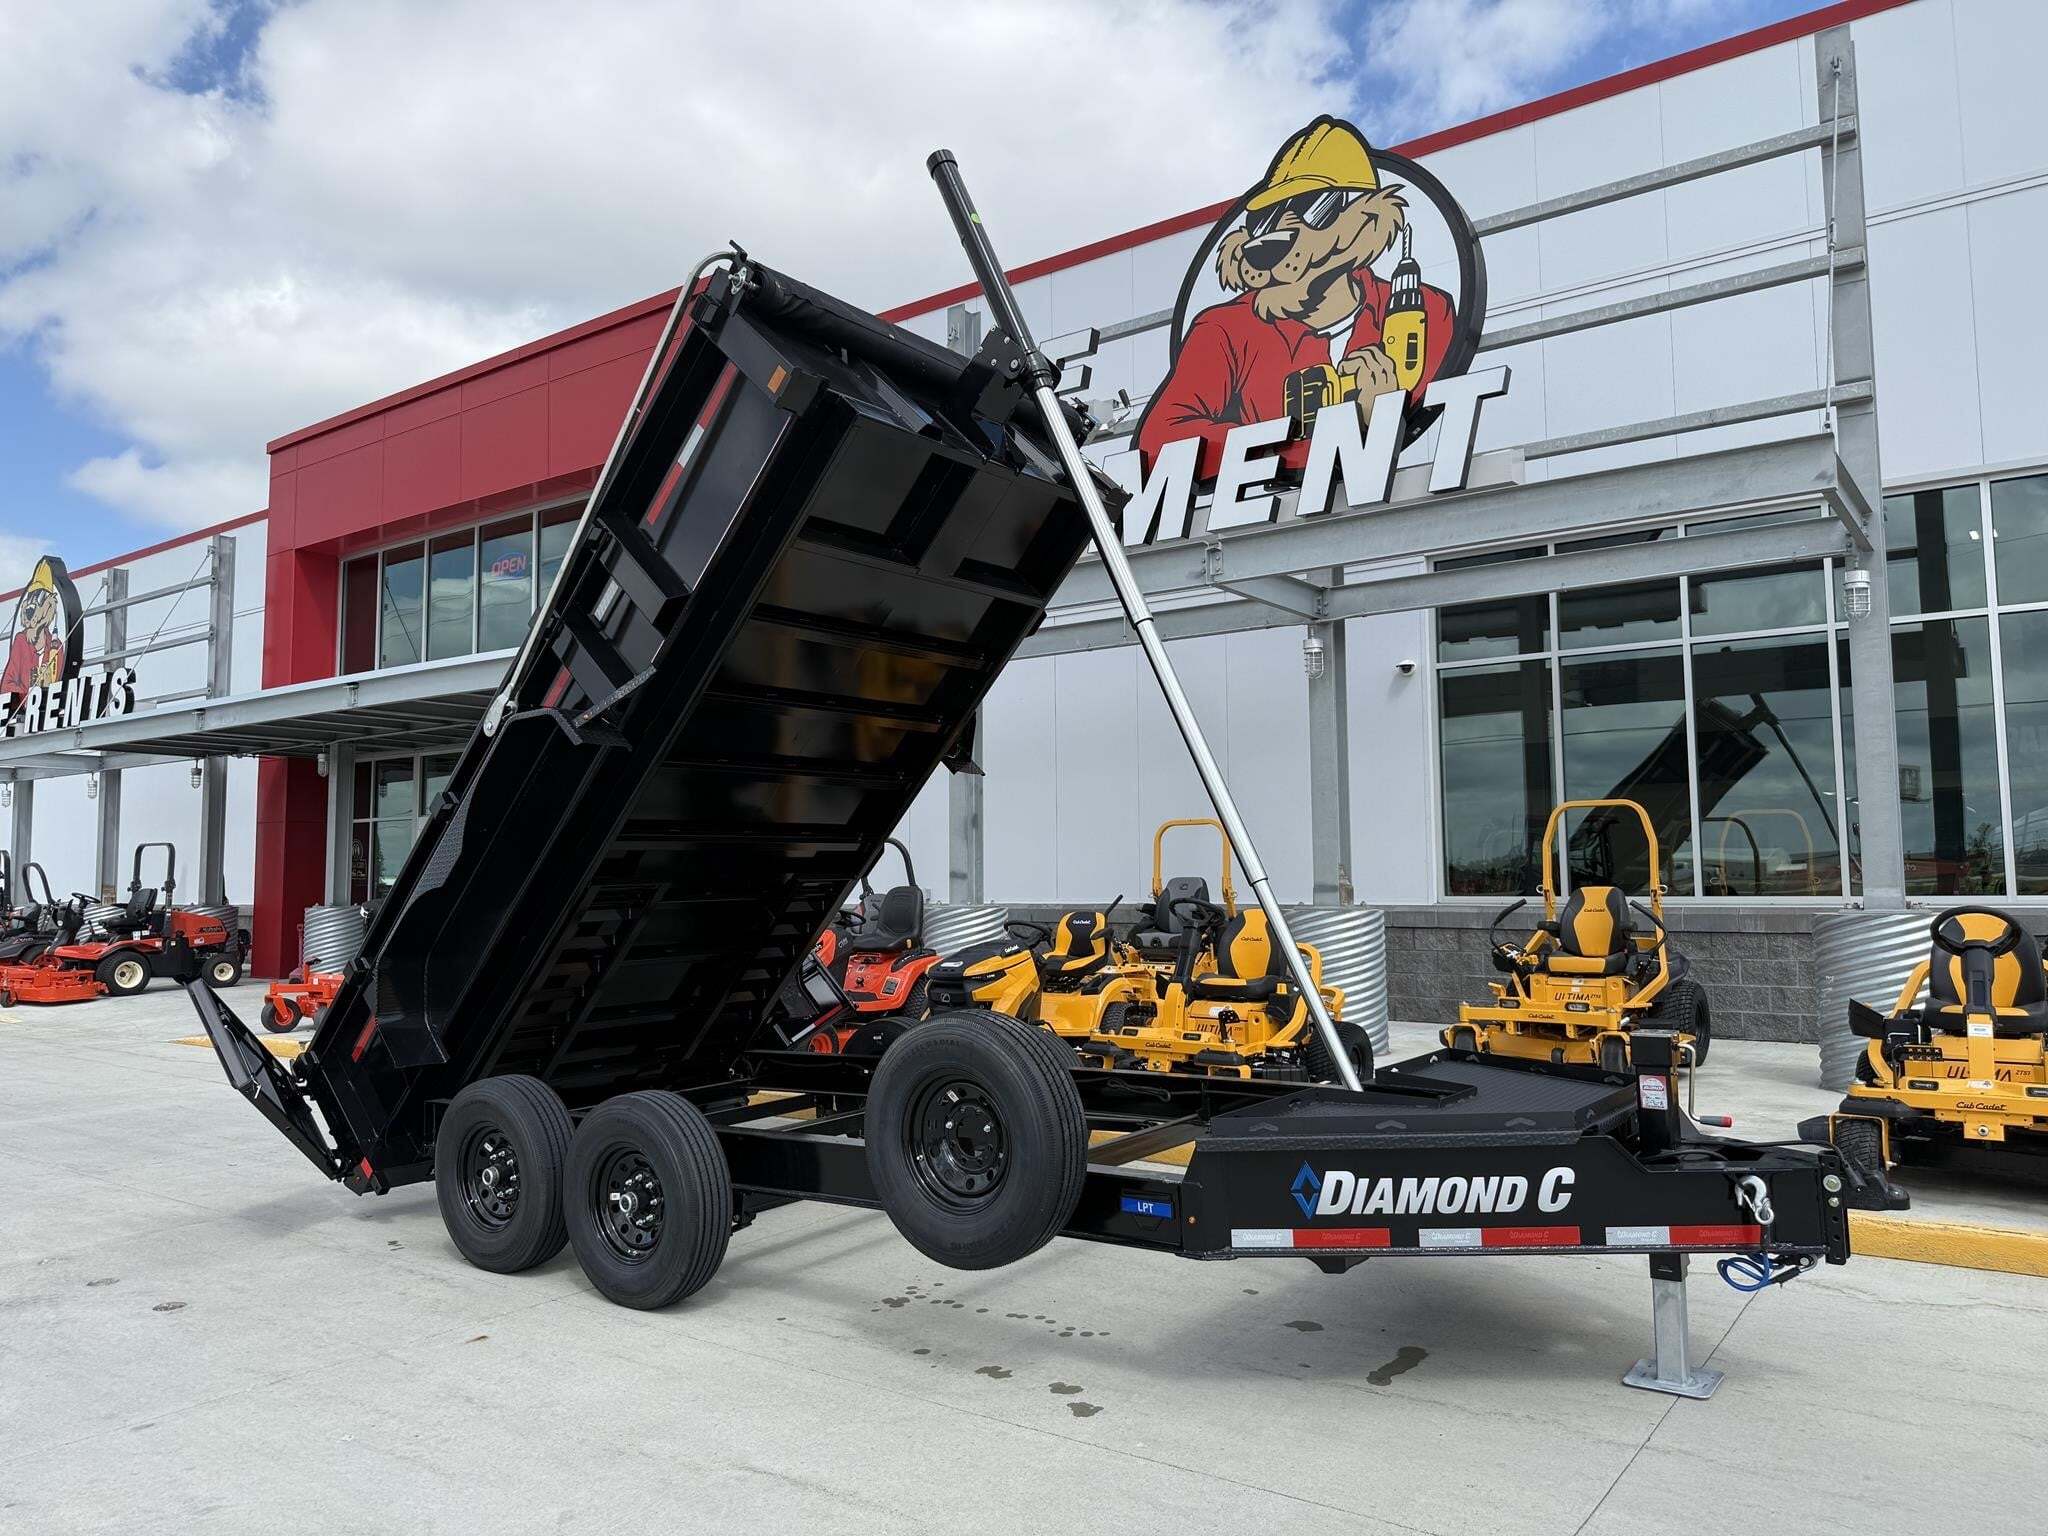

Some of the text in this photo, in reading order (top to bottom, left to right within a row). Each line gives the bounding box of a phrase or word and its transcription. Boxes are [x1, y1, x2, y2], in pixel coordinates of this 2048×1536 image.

[490, 555, 528, 576] OPEN
[24, 667, 136, 734] RENTS
[1955, 1101, 2007, 1112] Cub Cadet
[1315, 1167, 1576, 1215] DIAMOND C
[1137, 1200, 1154, 1214] LPT
